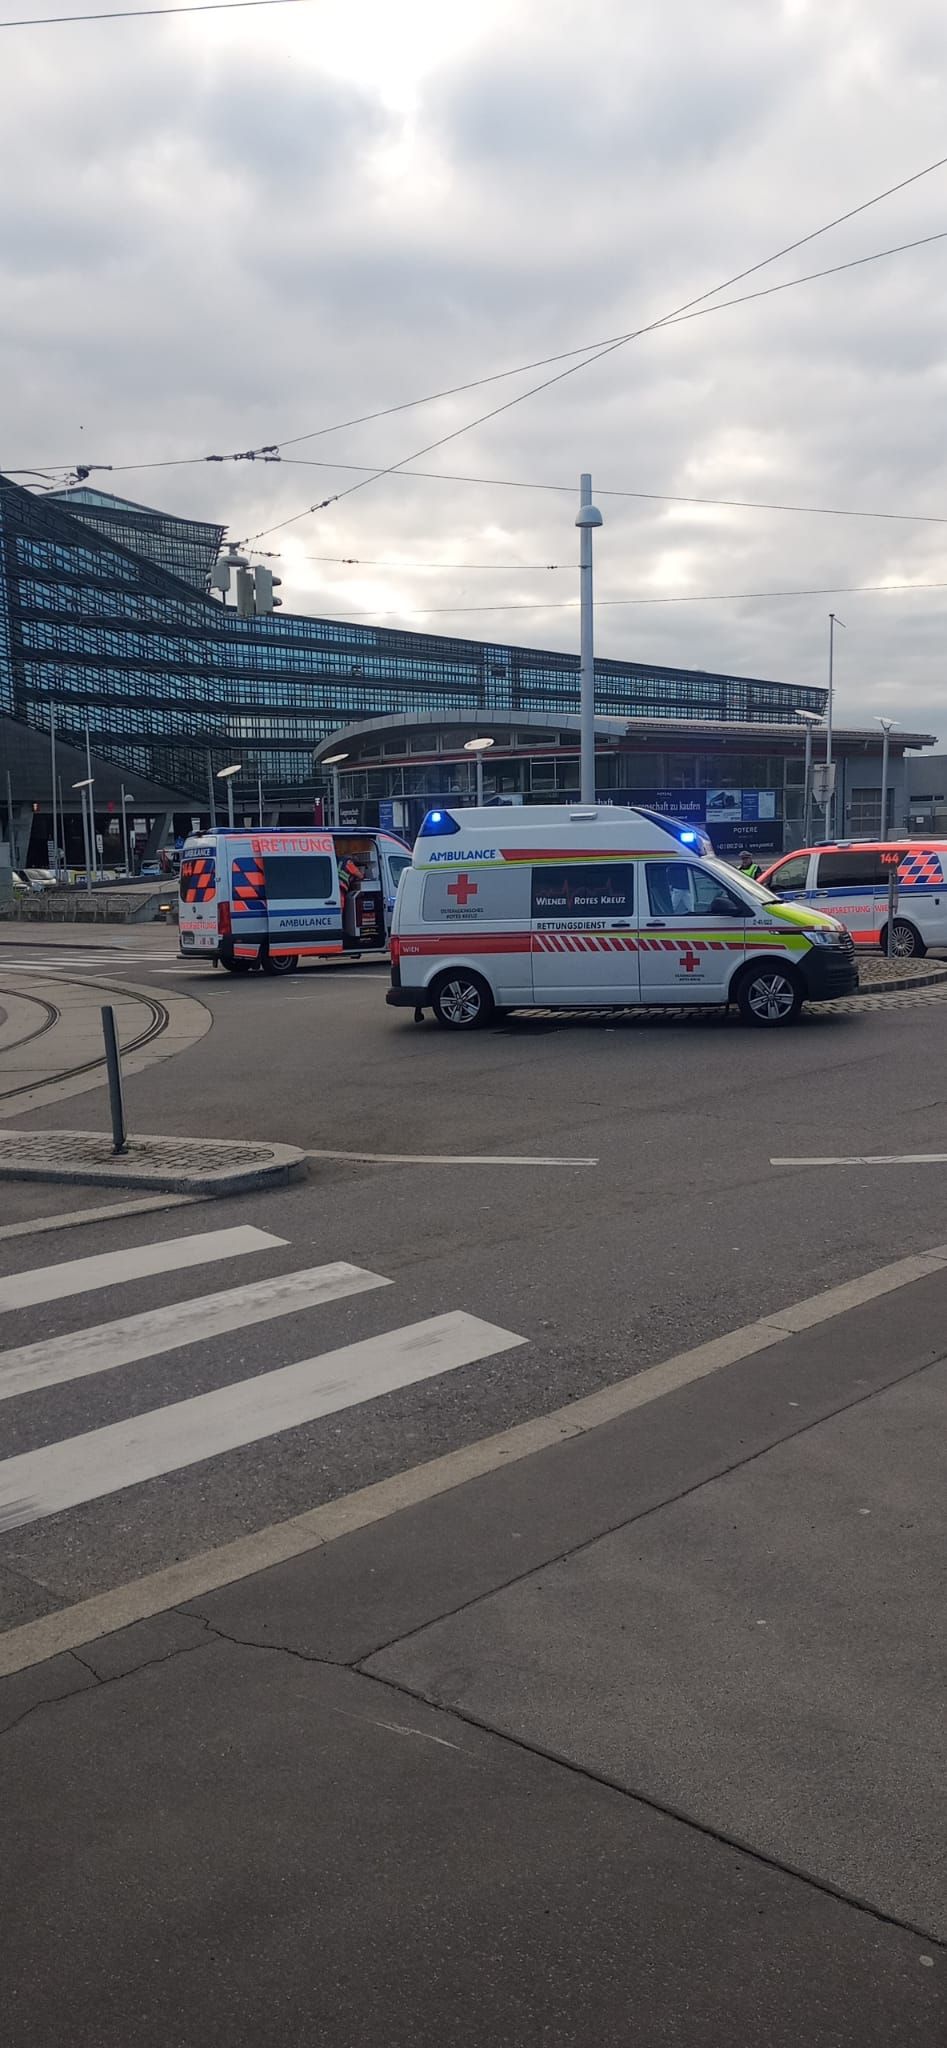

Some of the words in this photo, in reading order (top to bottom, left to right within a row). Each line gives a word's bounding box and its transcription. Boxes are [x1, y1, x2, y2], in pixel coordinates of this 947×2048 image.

[679, 800, 701, 811] kaufen
[429, 849, 497, 862] AMBULANCE
[880, 853, 900, 864] 144
[536, 897, 567, 906] WIENER
[574, 896, 599, 905] ROTES
[600, 895, 626, 905] KREUZ
[874, 903, 889, 913] WIE
[279, 917, 332, 928] AMBULANCE
[537, 921, 607, 930] RETTUNGSDIENST
